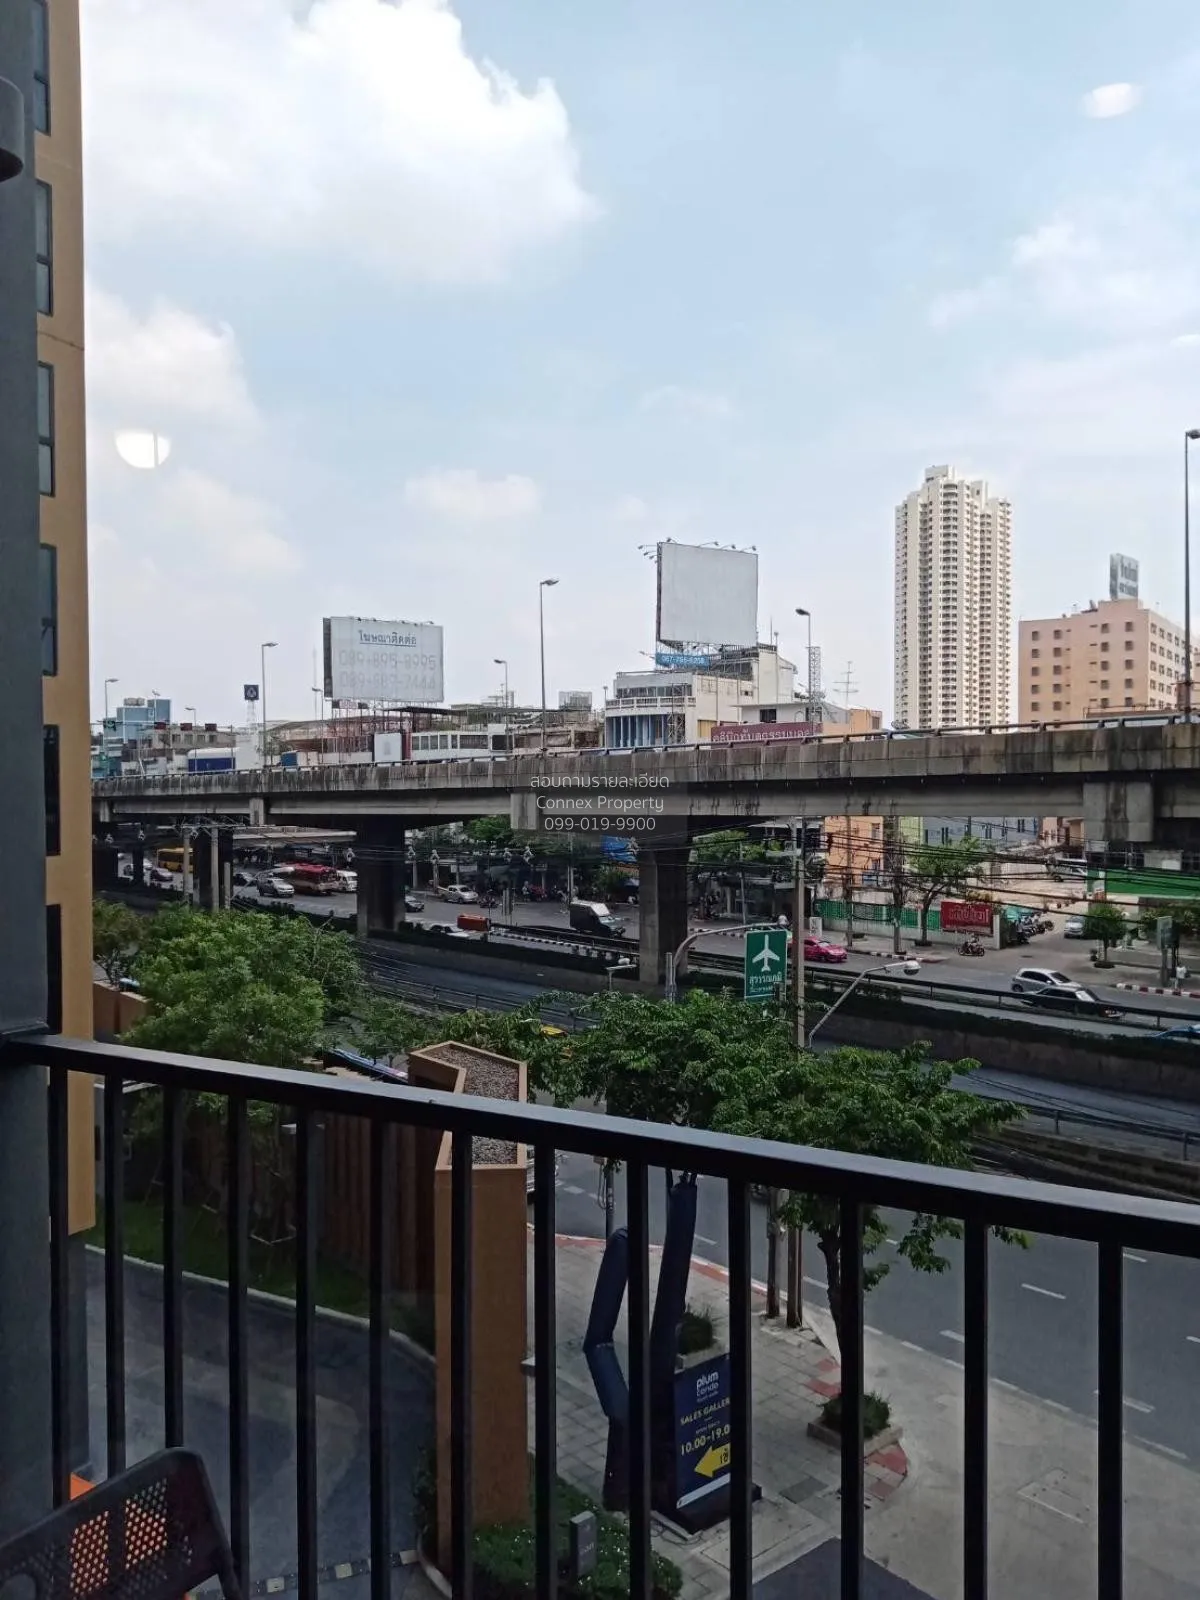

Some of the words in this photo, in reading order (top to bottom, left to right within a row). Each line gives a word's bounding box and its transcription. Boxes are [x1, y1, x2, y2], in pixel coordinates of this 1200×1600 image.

[696, 1371, 719, 1390] plum
[680, 1410, 703, 1426] SALES
[703, 1397, 731, 1416] GALLER
[681, 1424, 731, 1456] 10.00-19.0
